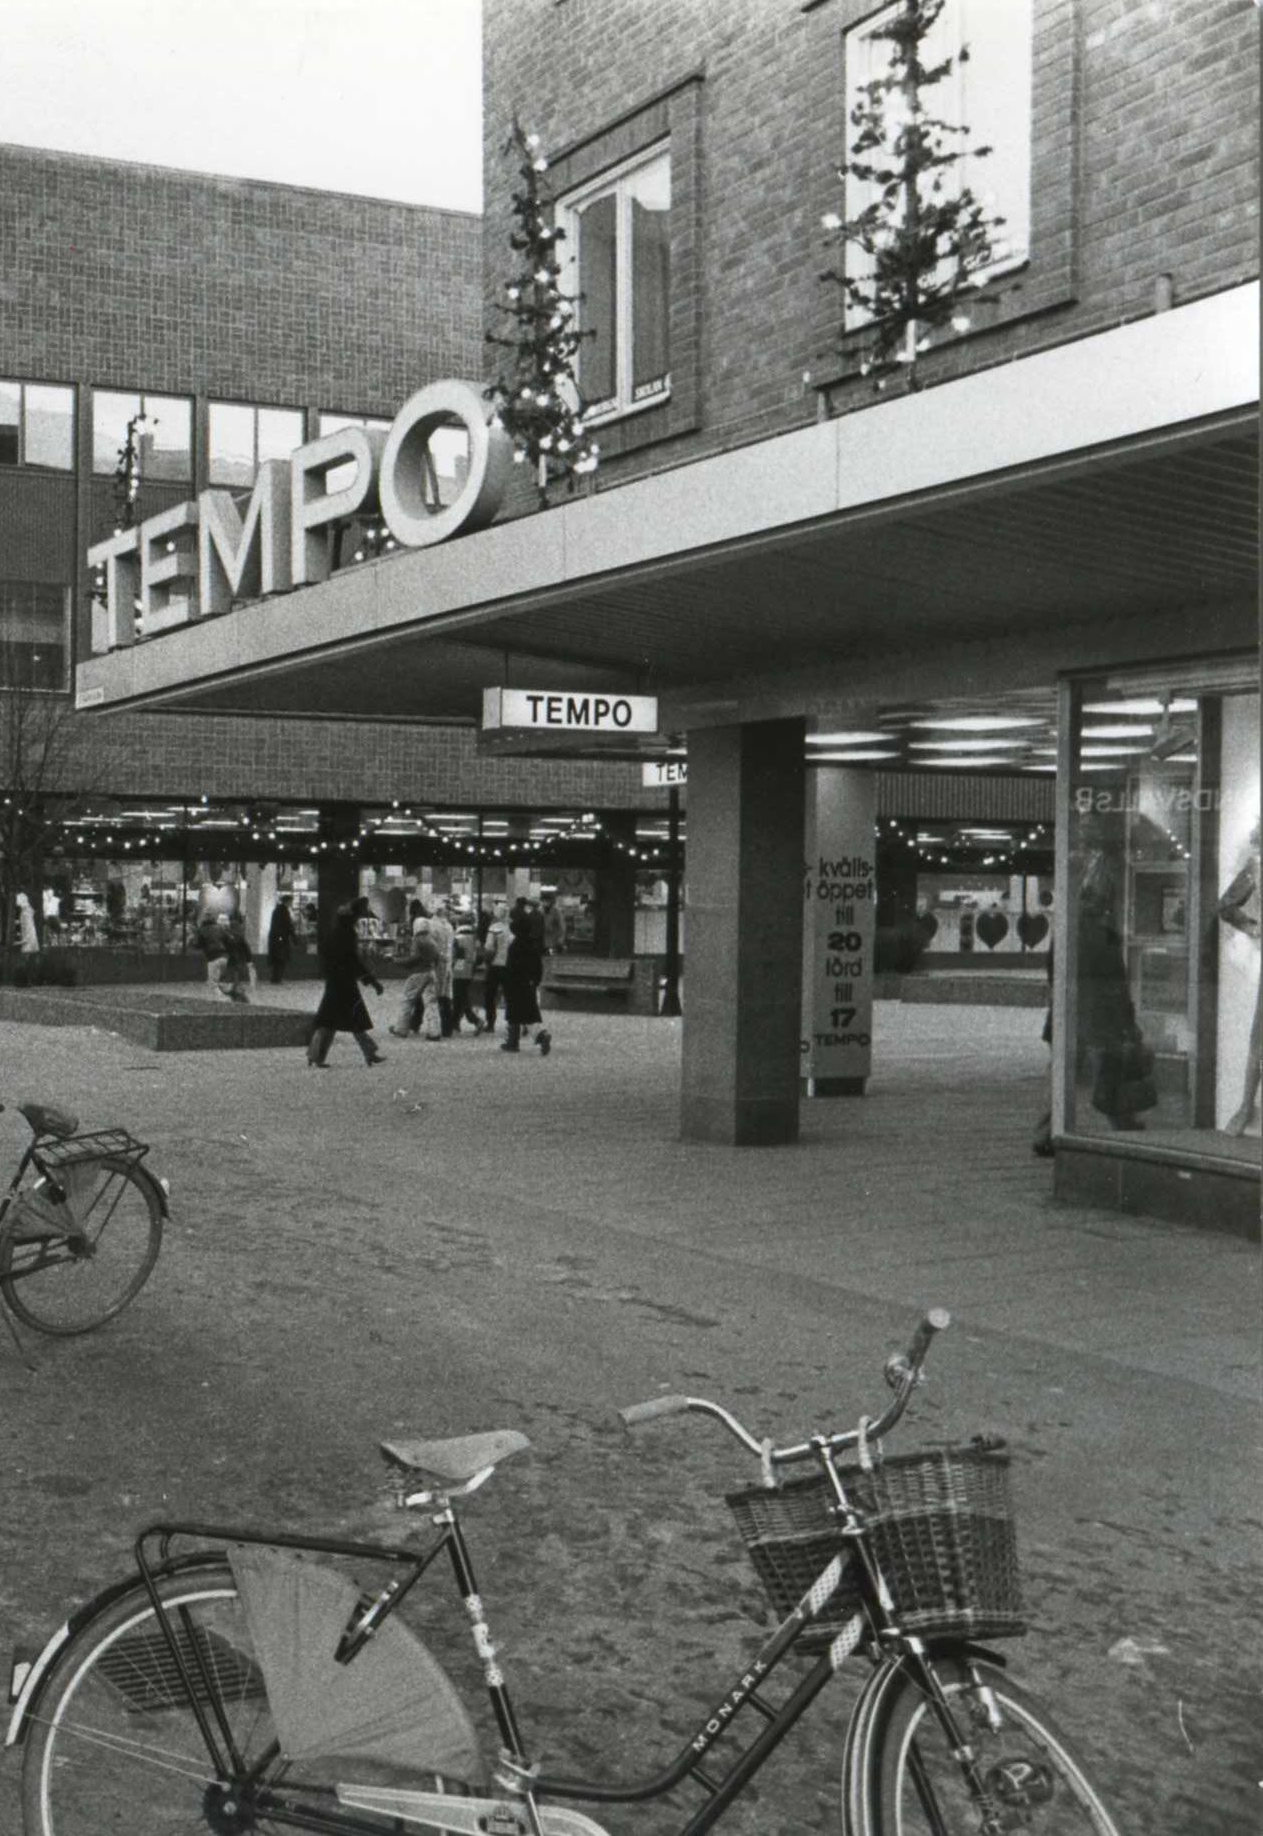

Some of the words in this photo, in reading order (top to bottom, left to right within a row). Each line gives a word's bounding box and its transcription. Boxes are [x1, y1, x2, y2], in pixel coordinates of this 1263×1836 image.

[87, 378, 503, 652] TEMPO
[527, 695, 632, 727] TEMPO
[819, 857, 874, 877] kvälls-
[817, 879, 873, 902] öppet
[836, 905, 854, 925] till
[827, 931, 862, 952] 20
[826, 957, 863, 977] lörd
[835, 982, 853, 1002] till
[830, 1007, 857, 1028] 17
[813, 1033, 872, 1047] TEMPO
[692, 1660, 767, 1752] MONARK
